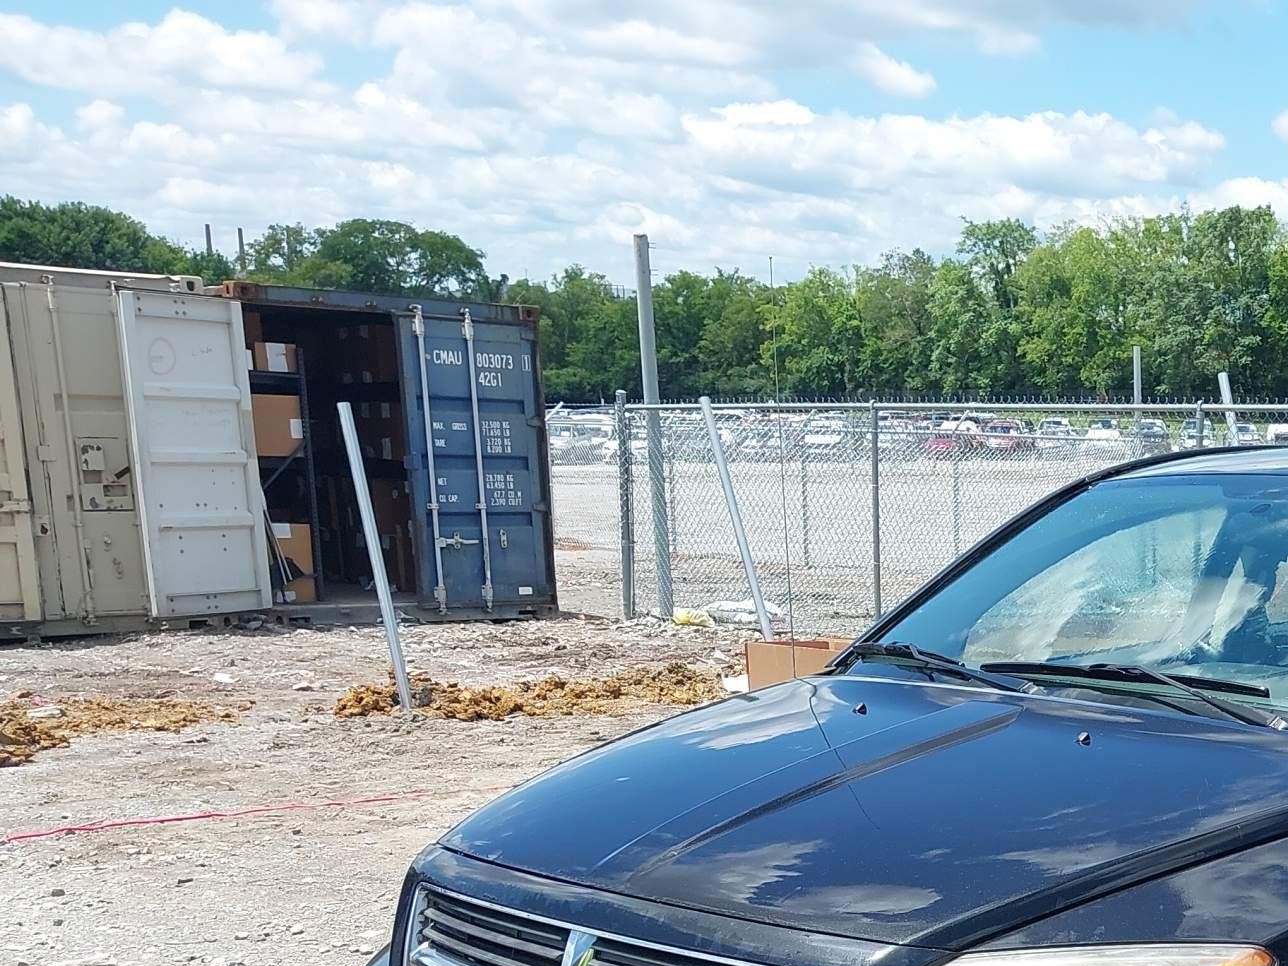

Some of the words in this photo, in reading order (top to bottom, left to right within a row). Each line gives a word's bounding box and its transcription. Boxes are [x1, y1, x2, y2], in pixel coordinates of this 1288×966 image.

[433, 350, 462, 365] CMAU
[476, 353, 514, 369] 803073
[479, 372, 502, 387] 42G1
[437, 477, 447, 486] NET
